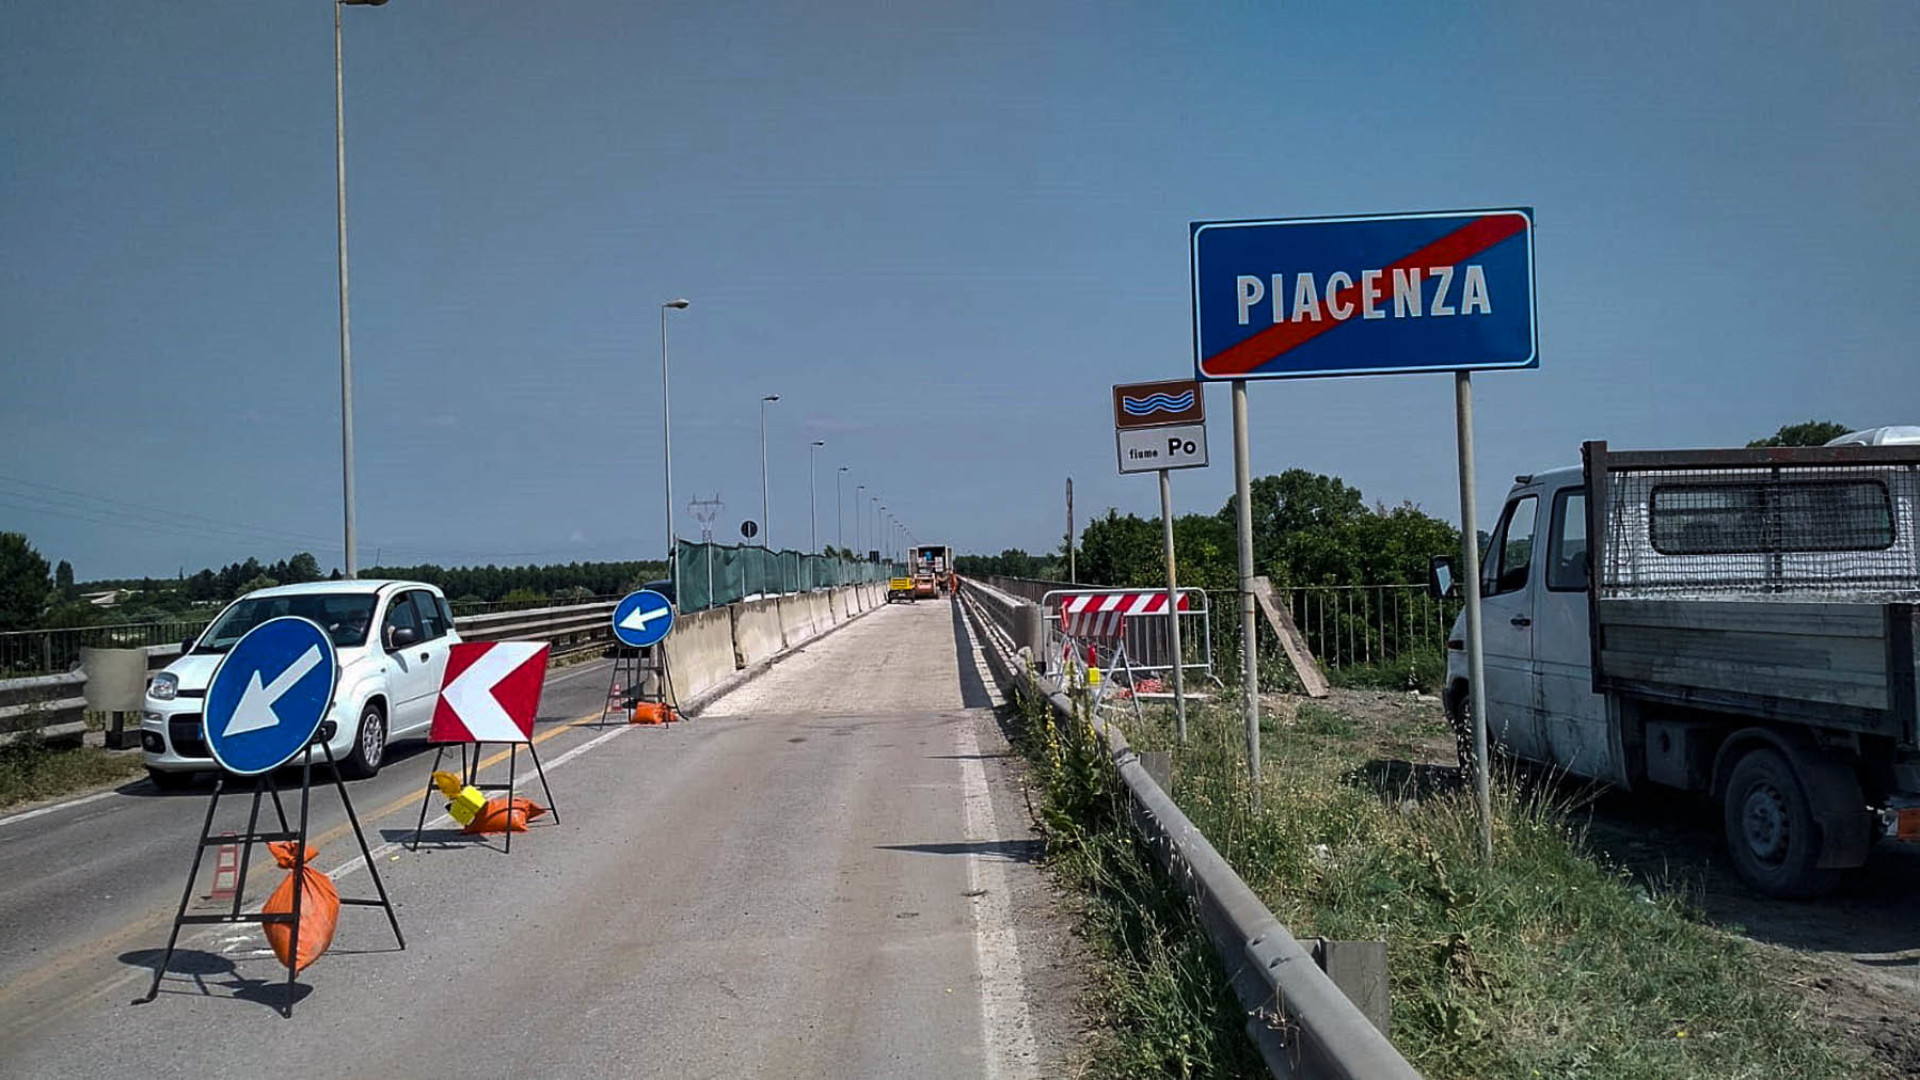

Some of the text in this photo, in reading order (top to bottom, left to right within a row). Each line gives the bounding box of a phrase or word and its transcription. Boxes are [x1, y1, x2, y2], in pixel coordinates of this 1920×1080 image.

[1237, 265, 1492, 325] PIACENZA
[1129, 438, 1196, 459] fiume Po
